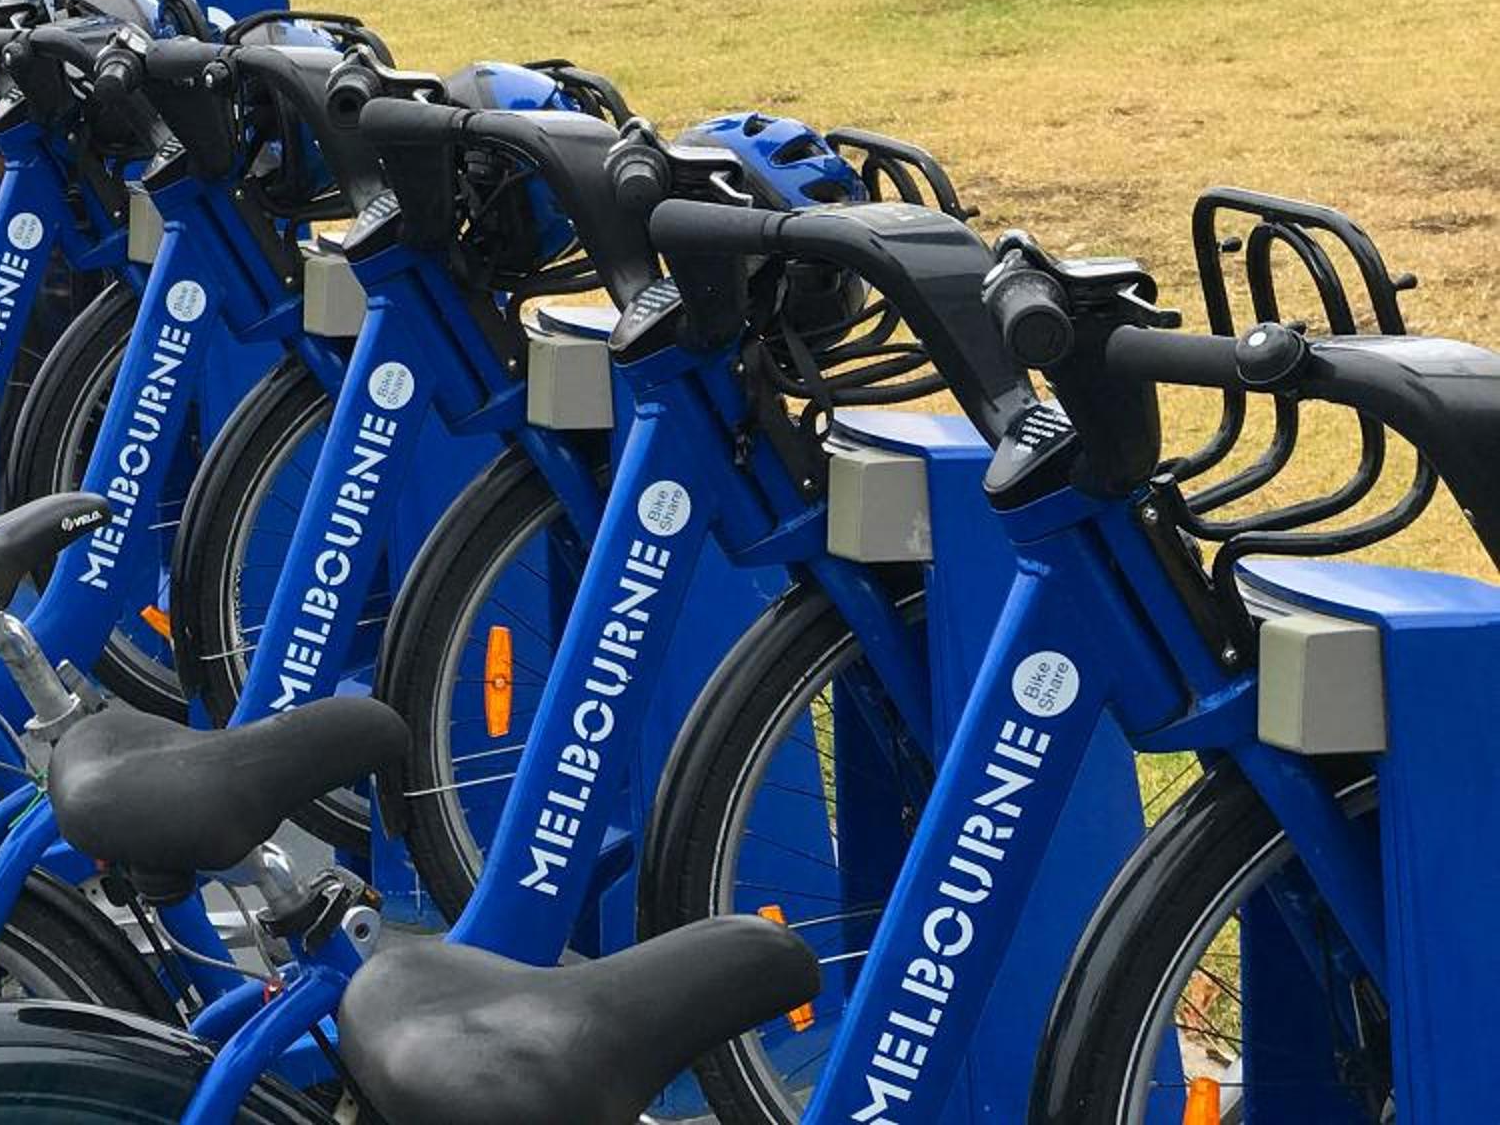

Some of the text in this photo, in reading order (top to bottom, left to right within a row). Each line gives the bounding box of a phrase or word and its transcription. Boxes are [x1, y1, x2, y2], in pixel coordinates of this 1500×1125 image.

[78, 323, 192, 591] MELBOURNE
[647, 490, 668, 522] Bike
[660, 490, 683, 532] Share
[269, 411, 398, 712] MELBOURNE
[518, 538, 671, 897] MELBOURNE
[1023, 662, 1051, 700] Bike
[1037, 662, 1069, 712] Share
[850, 719, 1052, 1125] MELBOURNE
